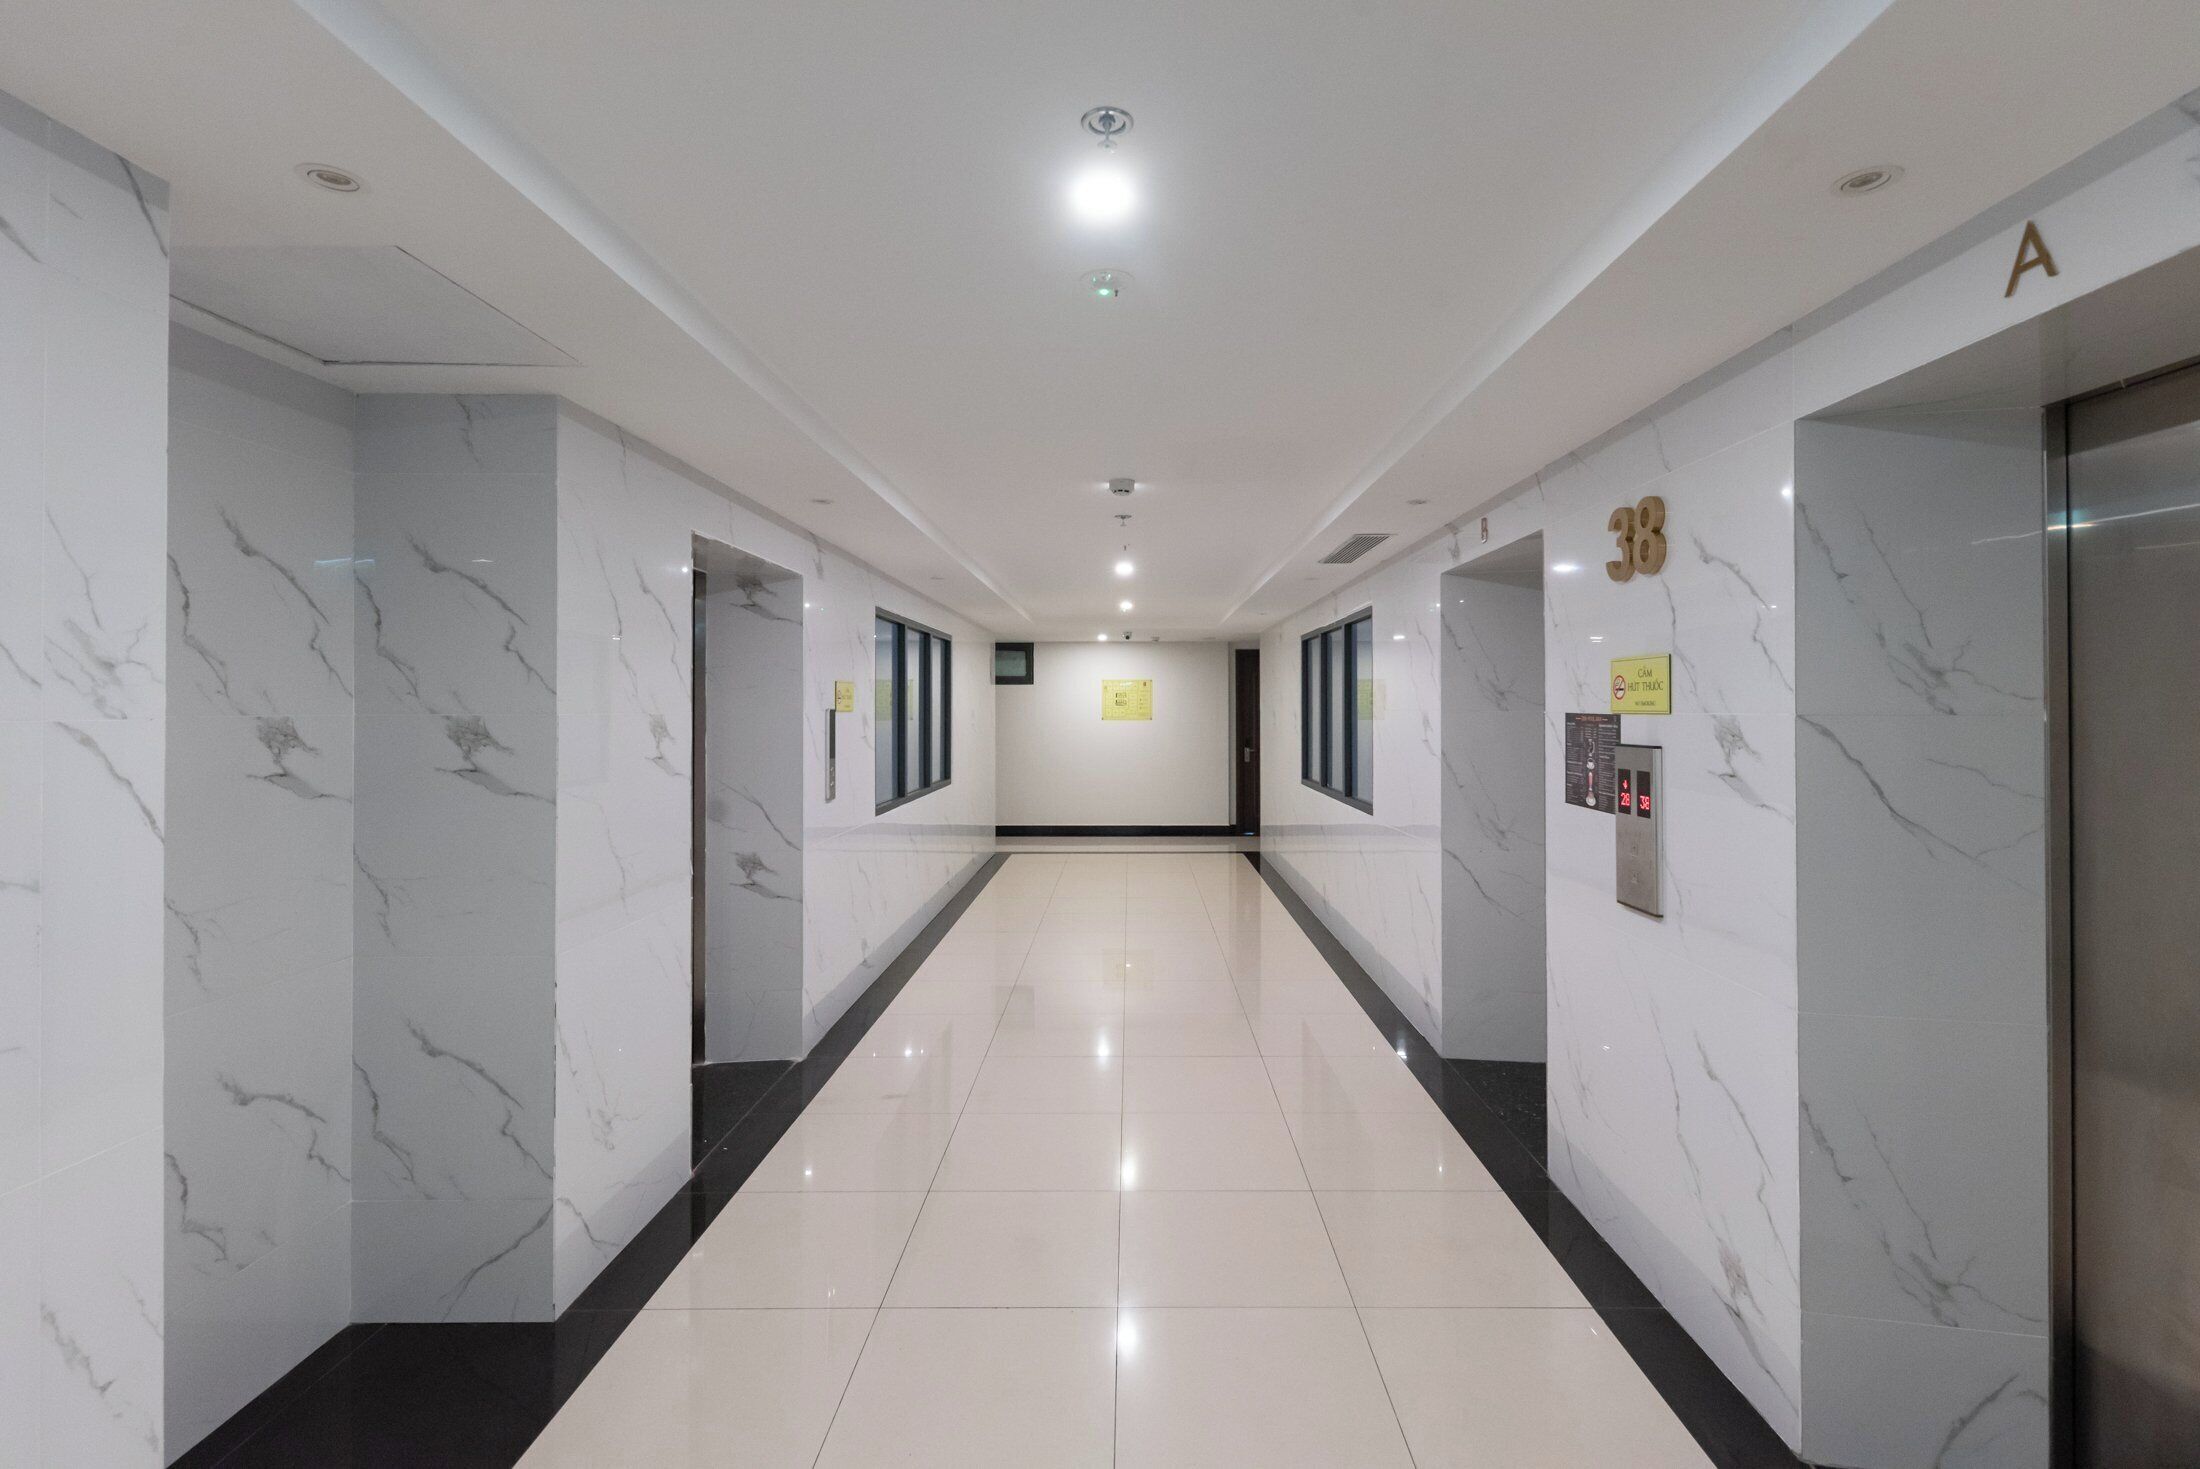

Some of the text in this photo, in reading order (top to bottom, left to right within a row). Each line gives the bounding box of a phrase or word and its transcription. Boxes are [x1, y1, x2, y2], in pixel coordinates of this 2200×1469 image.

[2004, 220, 2060, 298] A
[1606, 496, 1667, 583] 38
[1620, 792, 1630, 806] 28
[1640, 795, 1650, 810] 38
